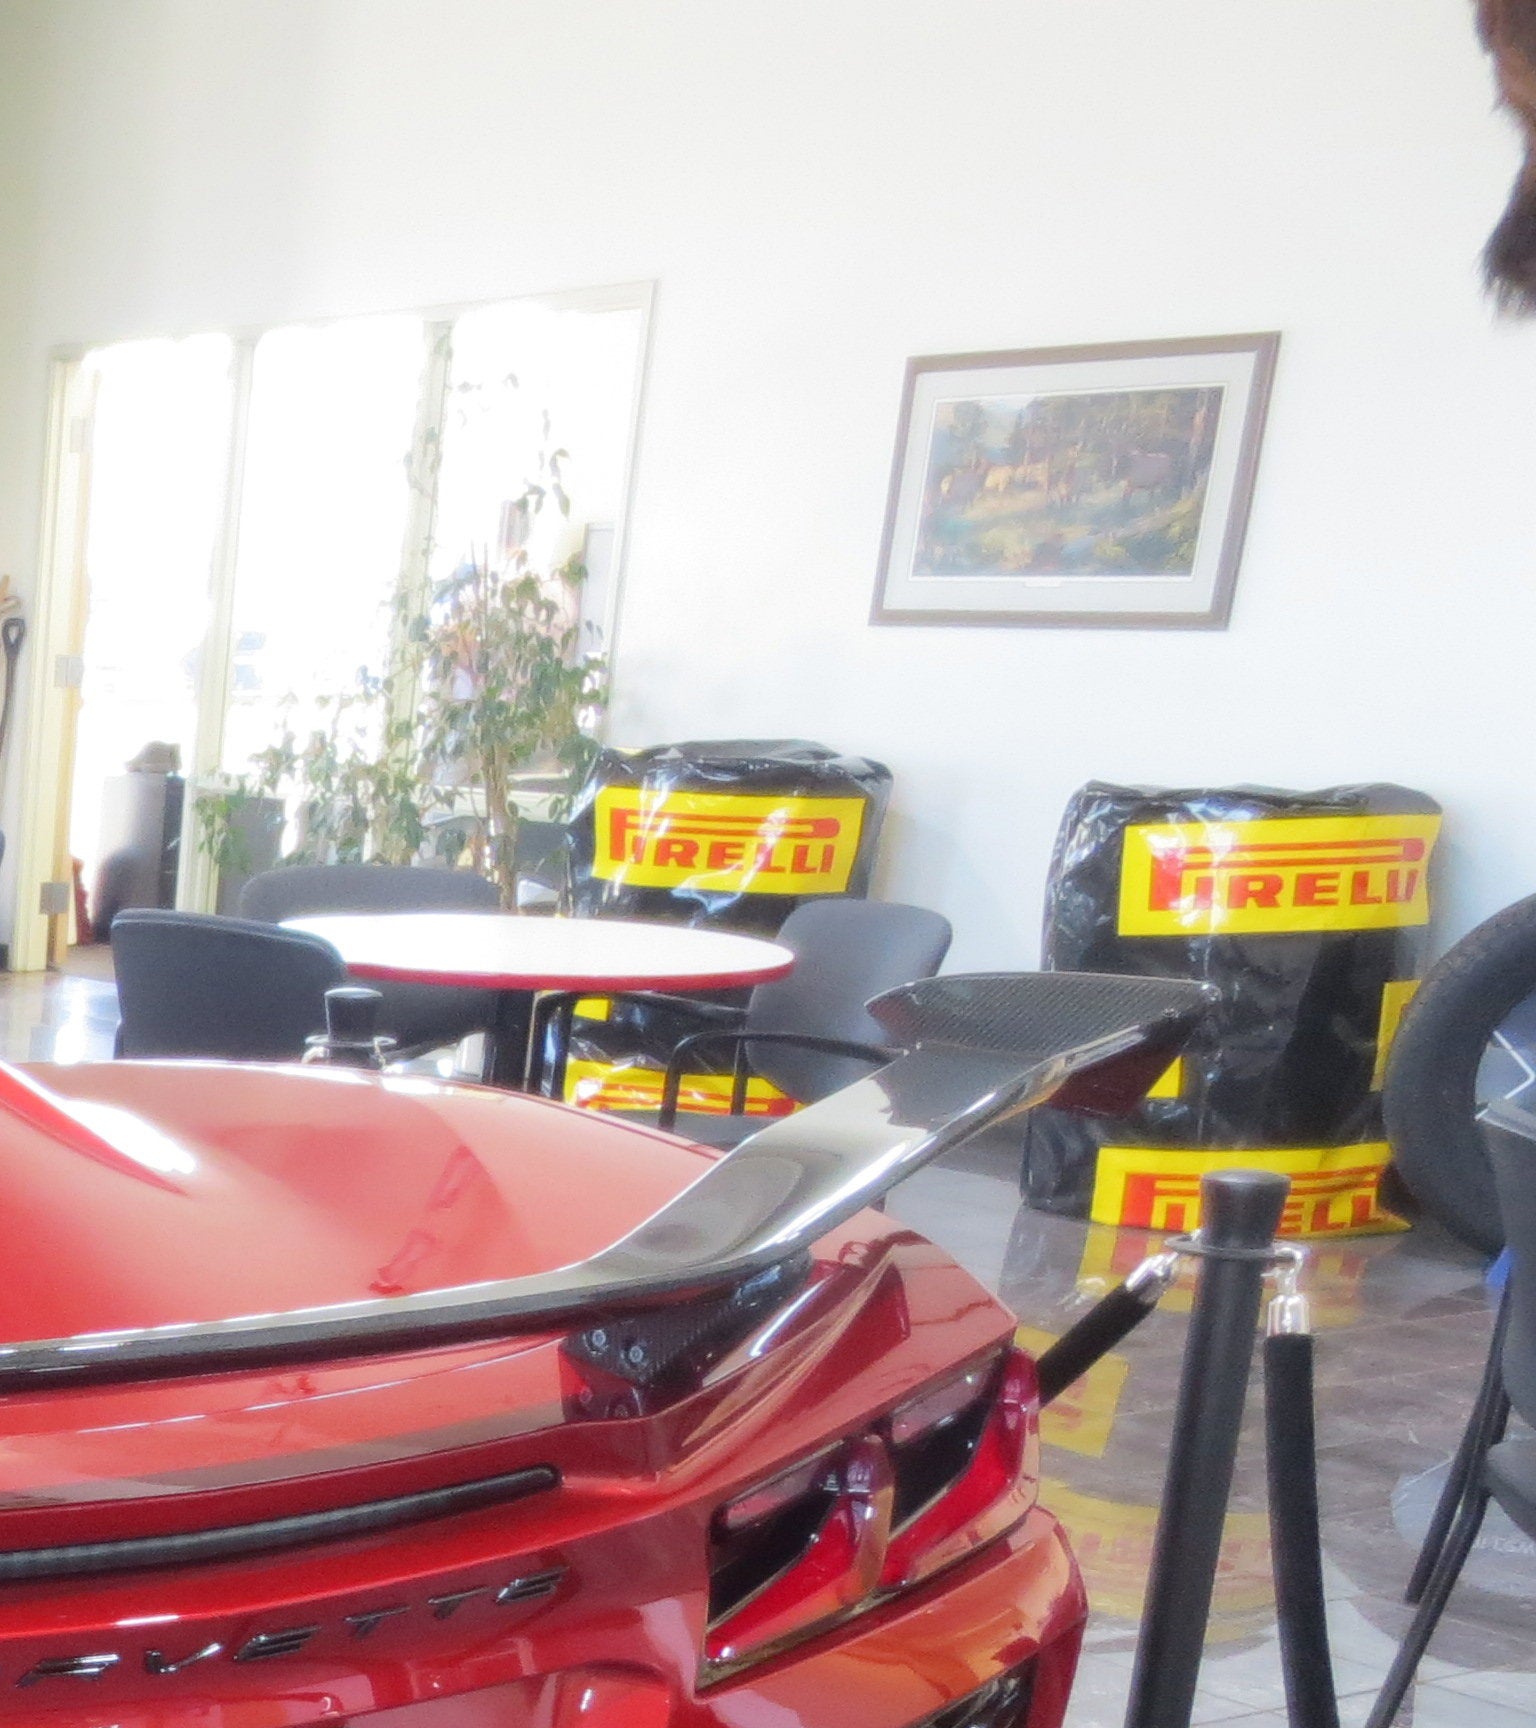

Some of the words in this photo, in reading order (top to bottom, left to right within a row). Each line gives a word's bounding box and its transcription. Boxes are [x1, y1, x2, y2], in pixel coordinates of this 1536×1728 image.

[609, 806, 841, 874] PIRELLI
[1147, 837, 1426, 912] PIRELLI
[1118, 1164, 1385, 1235] PIELL
